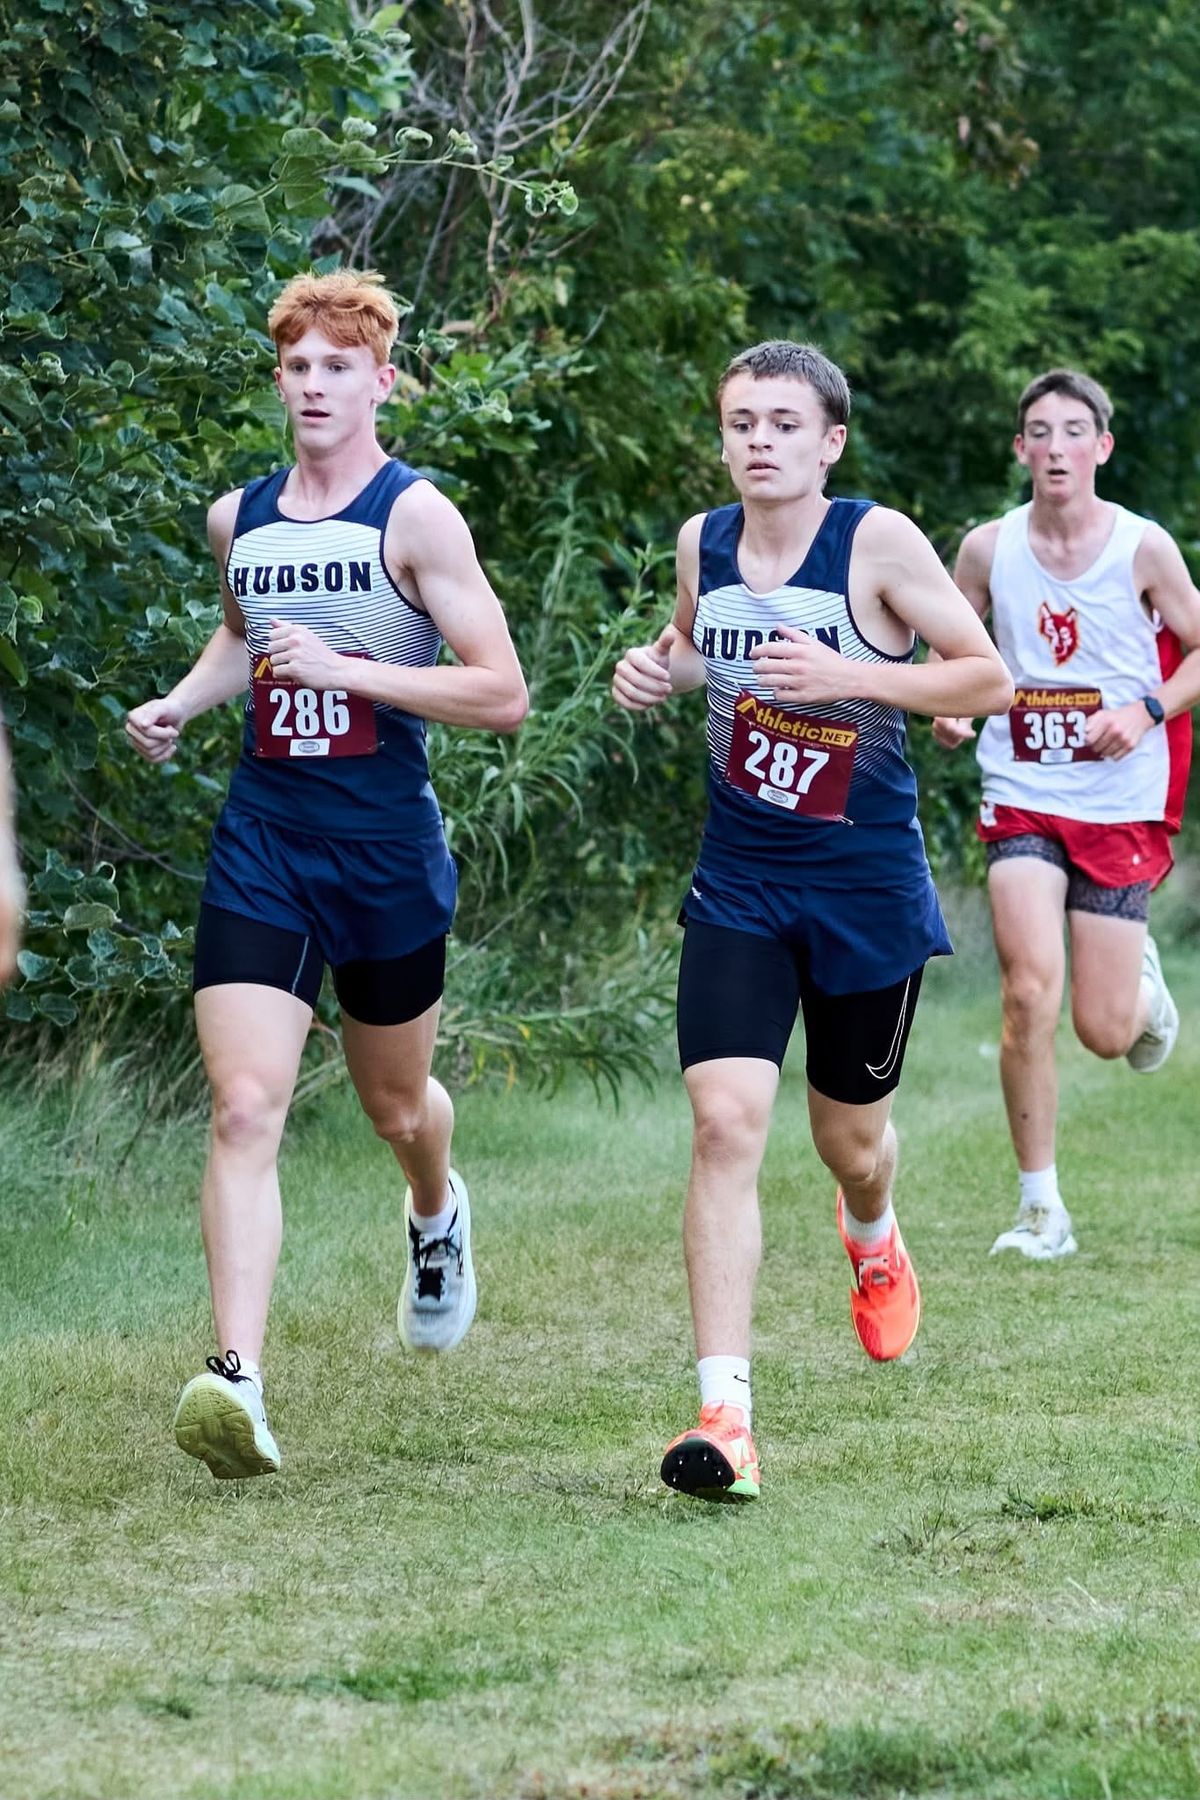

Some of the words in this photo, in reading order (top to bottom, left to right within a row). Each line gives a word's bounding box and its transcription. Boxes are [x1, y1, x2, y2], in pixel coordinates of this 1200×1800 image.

[233, 561, 372, 597] HUDSON
[701, 626, 842, 661] HUDN
[269, 688, 350, 737] 286
[736, 697, 820, 741] Athletic
[824, 732, 852, 744] NET
[1024, 711, 1086, 750] 363
[744, 730, 830, 794] 287
